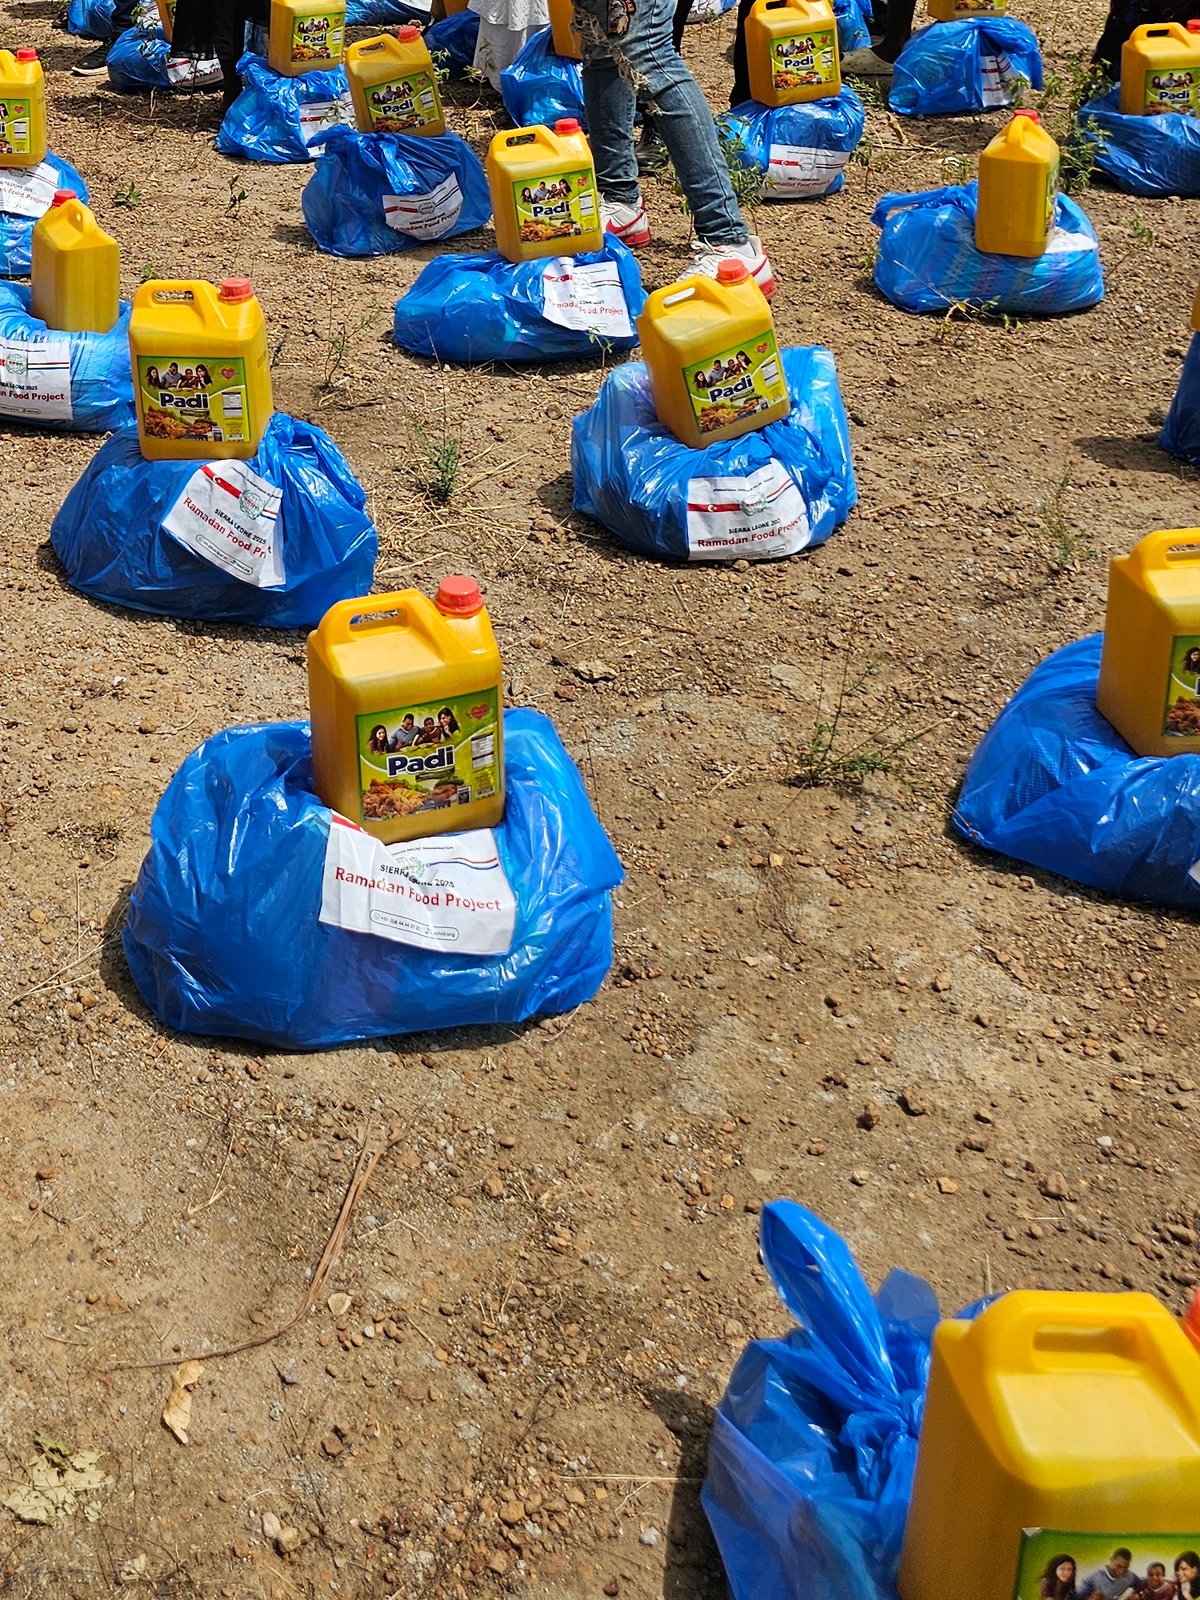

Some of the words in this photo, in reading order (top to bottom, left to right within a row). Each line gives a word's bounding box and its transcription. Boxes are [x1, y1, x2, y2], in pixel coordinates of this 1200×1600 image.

[302, 33, 327, 43] Padi
[782, 55, 815, 69] Padi
[1159, 90, 1190, 101] Padi
[381, 98, 414, 116] Padi
[531, 200, 571, 218] Padi
[599, 307, 624, 316] Project
[8, 391, 29, 400] Food
[31, 393, 65, 402] Project
[708, 373, 754, 403] Padi
[159, 391, 210, 410] Padi
[183, 496, 226, 535] Ramadan
[226, 530, 252, 551] Food
[214, 507, 235, 526] SIERRA
[234, 521, 253, 539] LEONE
[728, 526, 751, 535] SIERRA
[751, 521, 770, 531] LEONE
[697, 536, 748, 548] Ramadan
[751, 529, 775, 541] Food
[387, 745, 455, 778] Padi
[335, 866, 405, 896] Ramadan
[408, 887, 440, 907] Food
[445, 892, 502, 912] Project
